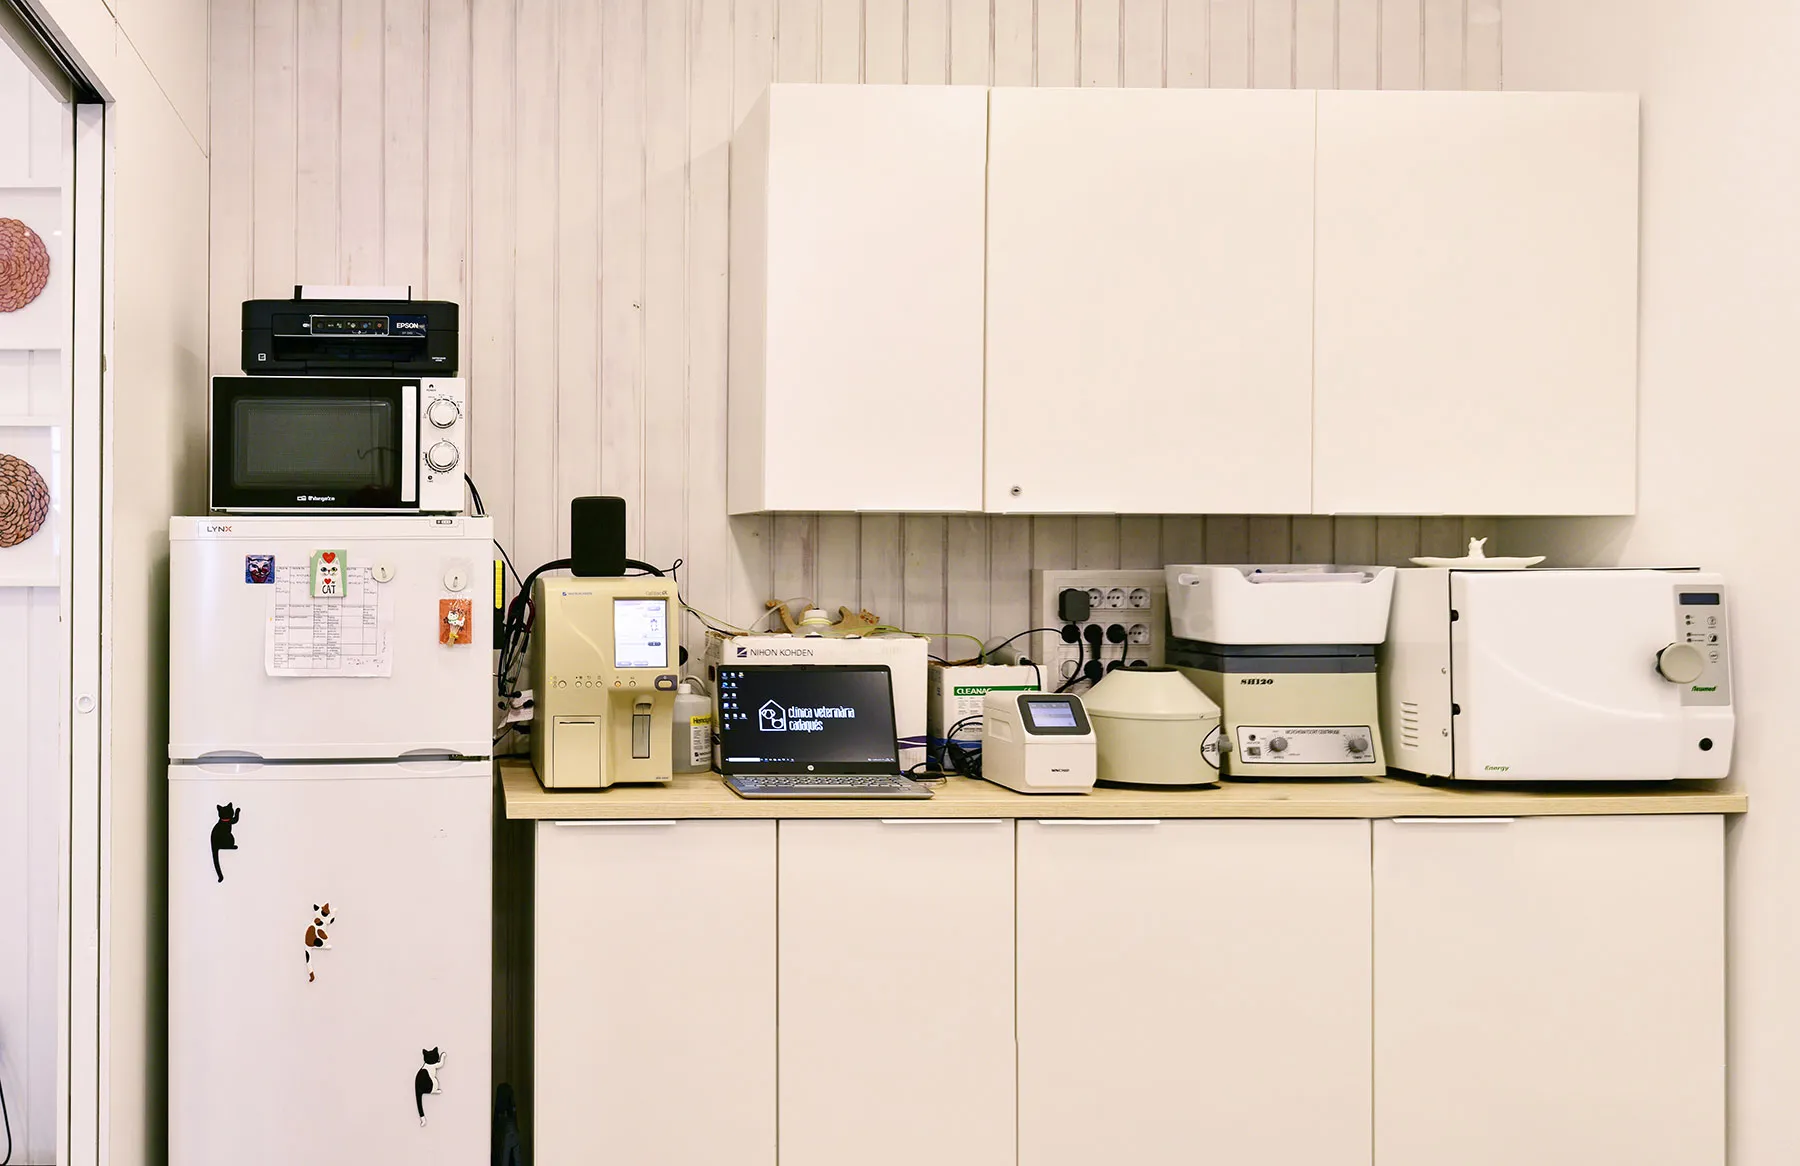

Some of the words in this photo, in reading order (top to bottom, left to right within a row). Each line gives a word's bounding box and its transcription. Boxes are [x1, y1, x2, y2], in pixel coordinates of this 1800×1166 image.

[321, 584, 336, 595] CAT
[750, 648, 778, 656] NIHON
[780, 648, 814, 656] KOHDEN
